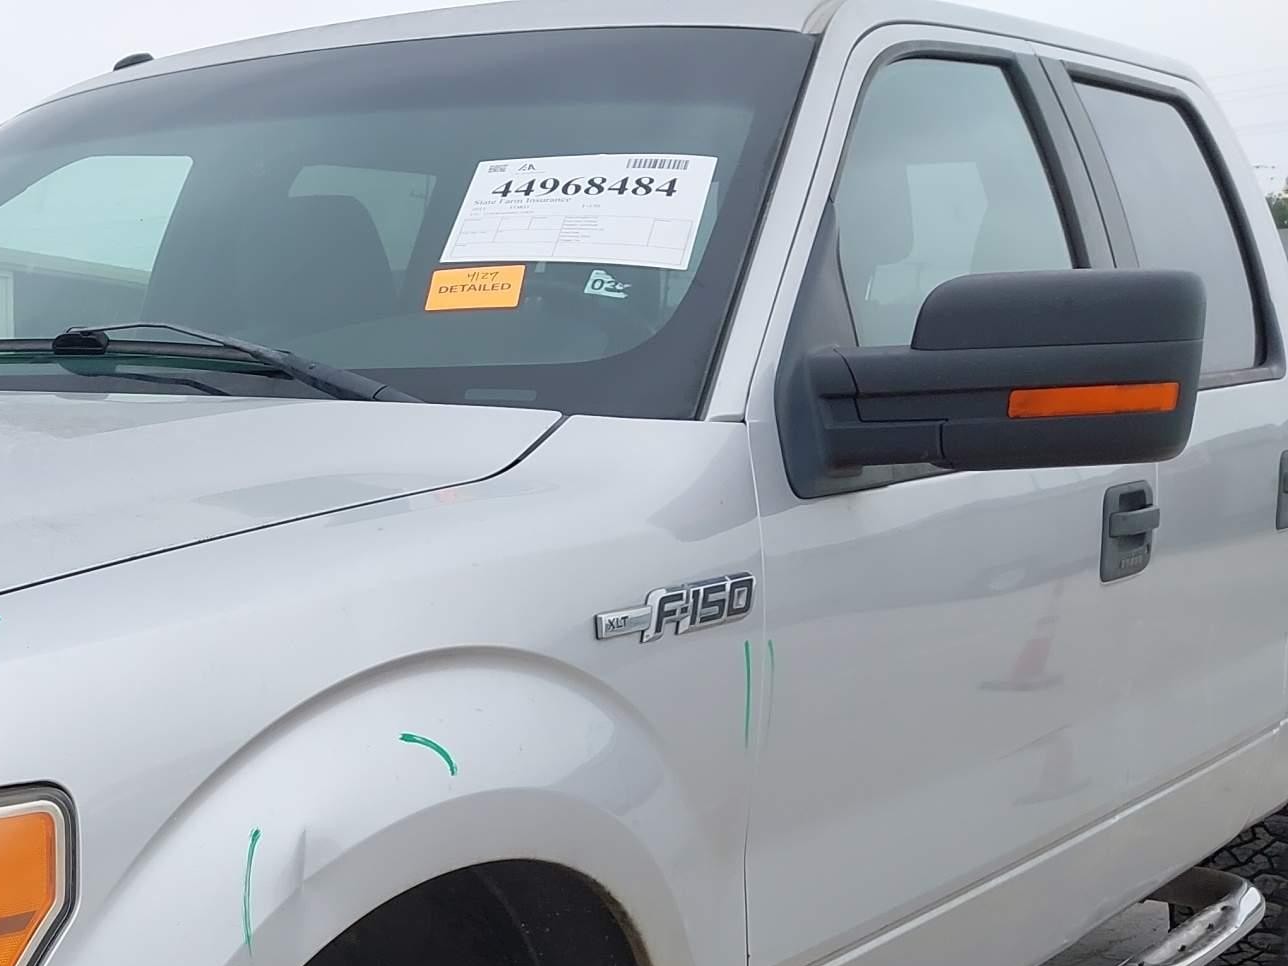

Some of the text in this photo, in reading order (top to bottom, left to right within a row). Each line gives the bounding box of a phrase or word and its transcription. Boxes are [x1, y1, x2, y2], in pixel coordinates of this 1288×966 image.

[492, 176, 678, 198] 44968484
[438, 282, 512, 294] DETAILED
[607, 616, 629, 630] XLT
